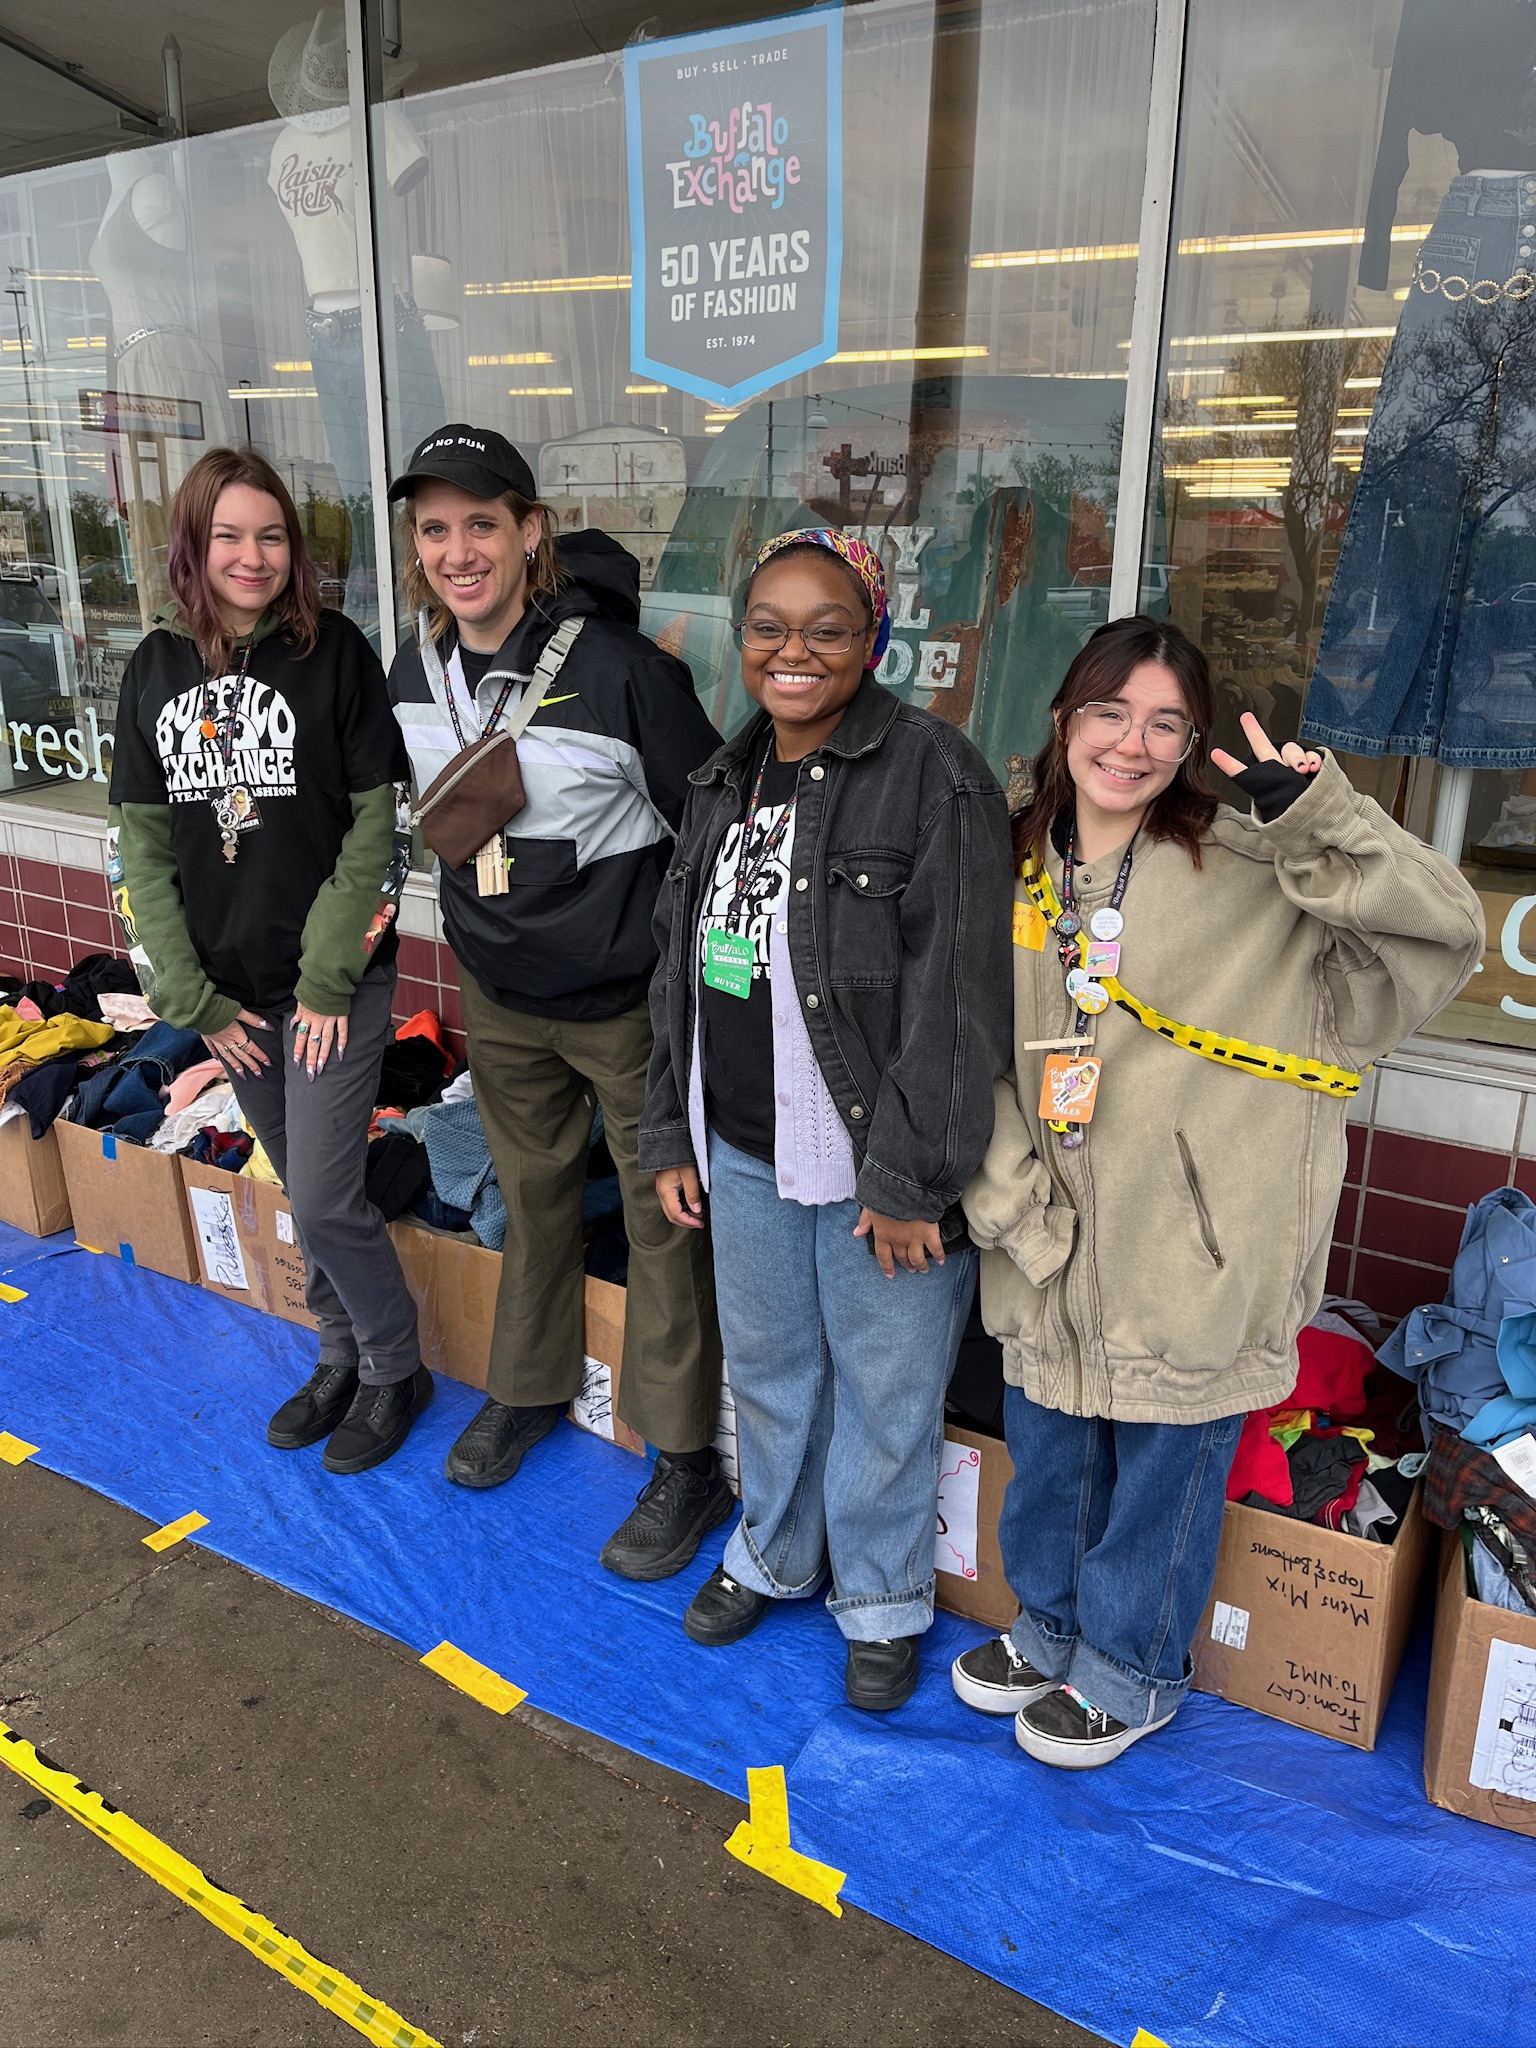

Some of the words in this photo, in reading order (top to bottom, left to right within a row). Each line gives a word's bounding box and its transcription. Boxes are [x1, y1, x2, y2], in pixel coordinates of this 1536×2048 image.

[677, 65, 698, 80] BUY
[712, 59, 739, 73] SELL
[752, 48, 788, 66] TRADE
[684, 101, 789, 163] Buffalo
[666, 156, 800, 213] Exchange
[661, 244, 699, 287] 50
[709, 230, 810, 282] YEARS
[671, 292, 696, 322] OF
[703, 282, 797, 319] FASHION
[706, 337, 727, 349] EST.
[731, 335, 755, 347] 1974
[435, 438, 454, 447] NO
[458, 437, 486, 452] FUN
[90, 608, 102, 621] No
[714, 976, 741, 991] BUYER
[1265, 1576, 1308, 1610] Mix
[1321, 1595, 1370, 1627] Mens
